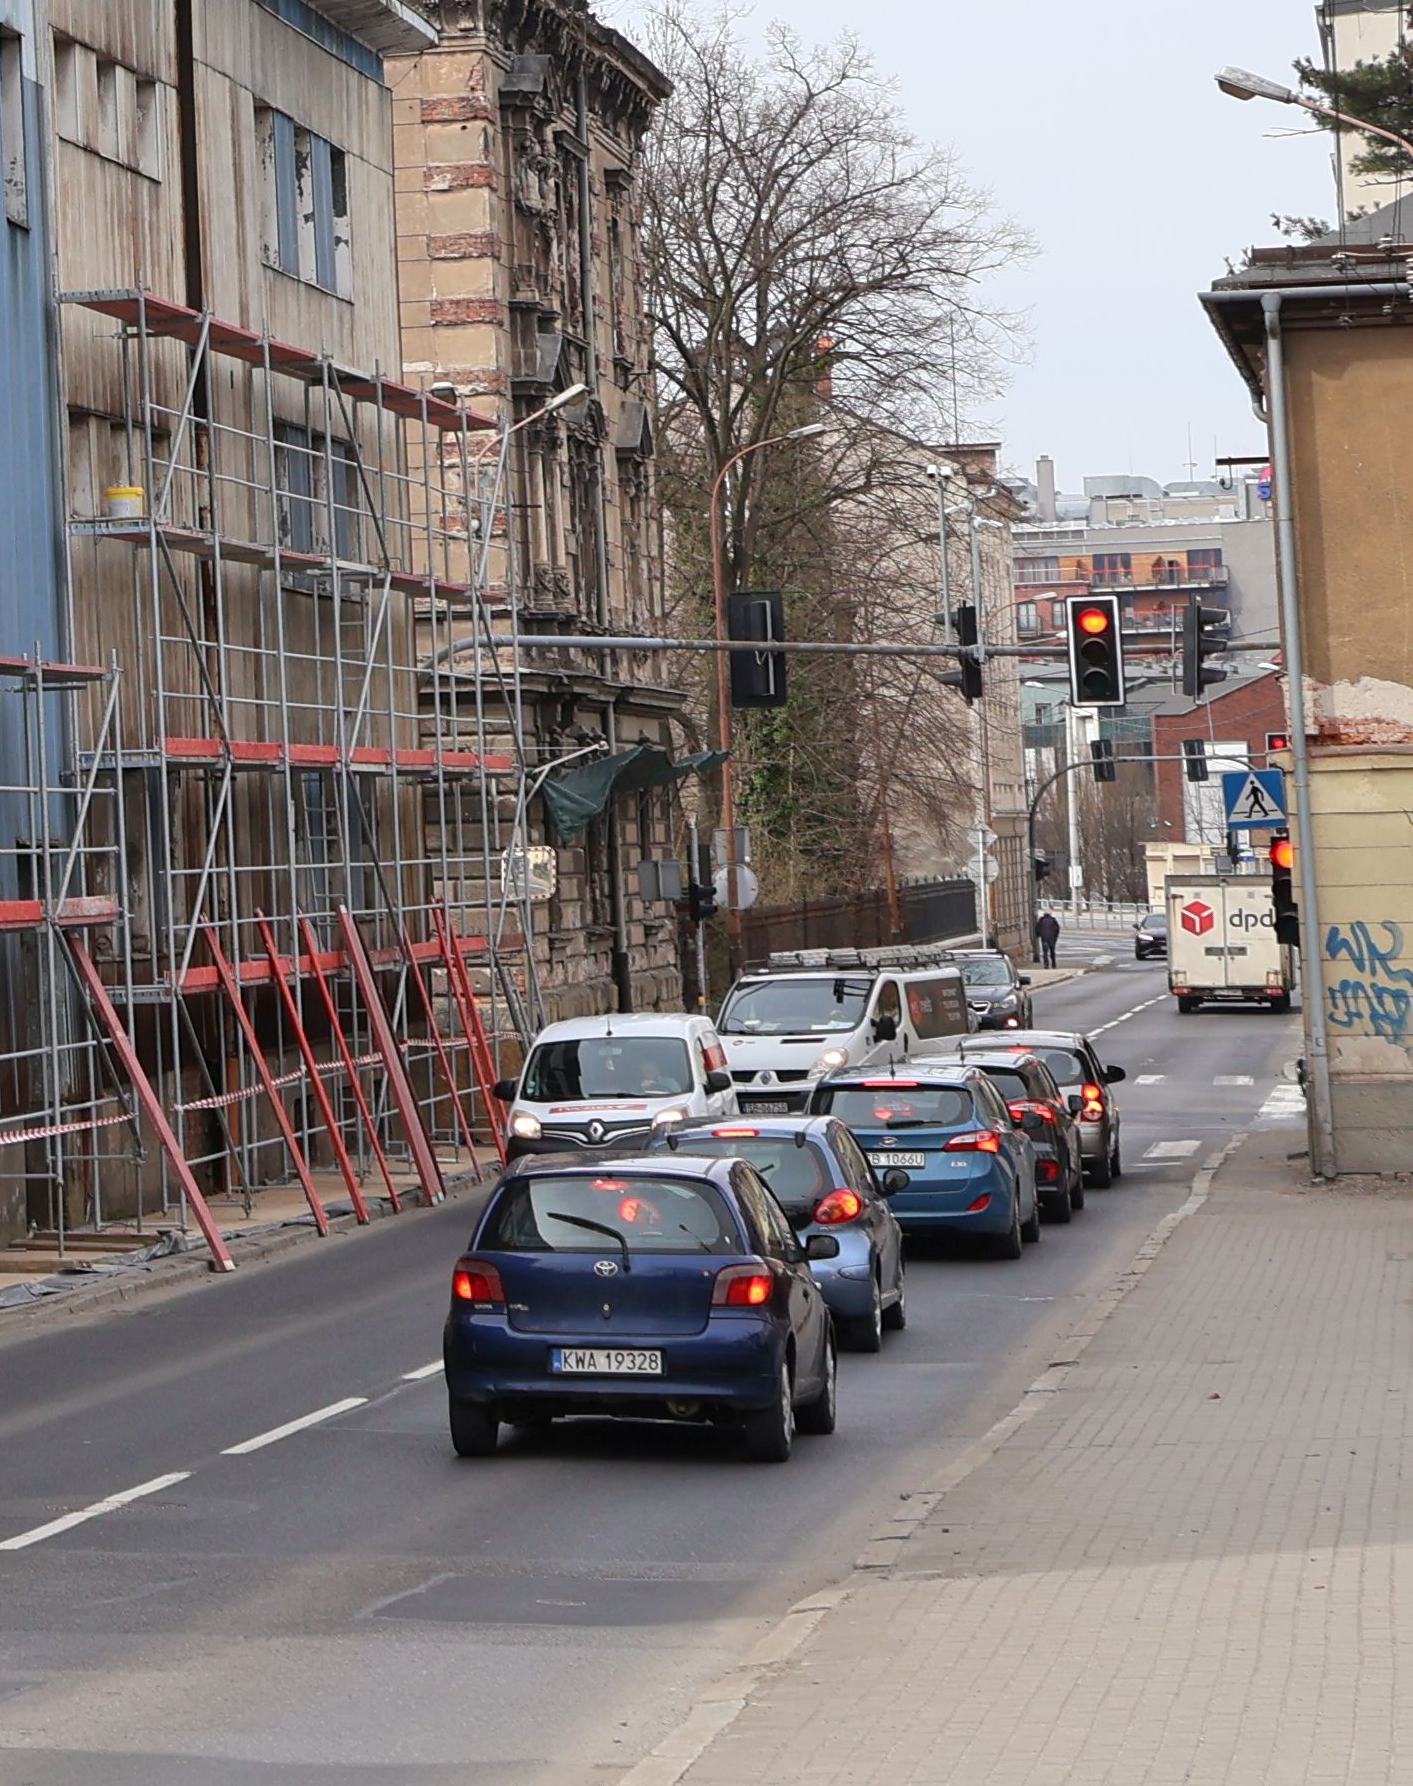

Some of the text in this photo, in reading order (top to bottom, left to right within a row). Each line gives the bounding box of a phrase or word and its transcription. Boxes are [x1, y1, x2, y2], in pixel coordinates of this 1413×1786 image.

[1229, 908, 1275, 933] dpd
[563, 1351, 659, 1371] KWA 19328
